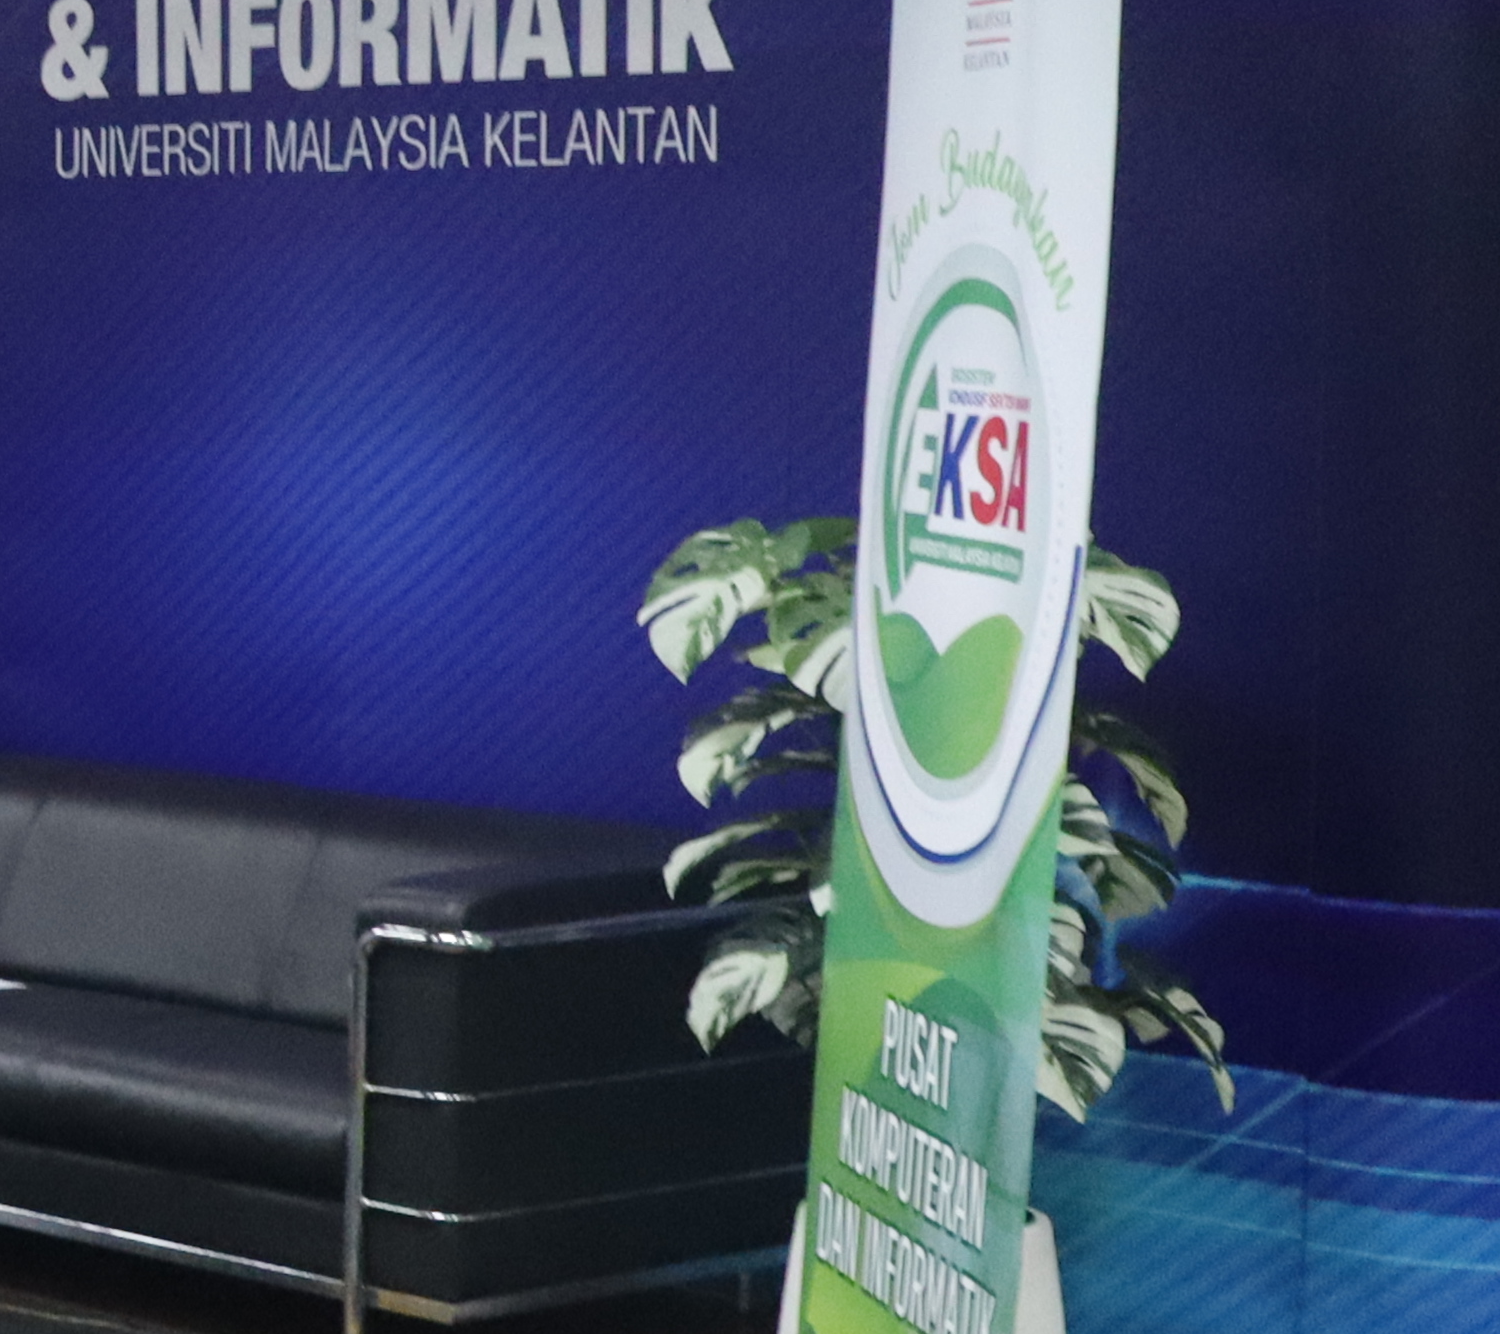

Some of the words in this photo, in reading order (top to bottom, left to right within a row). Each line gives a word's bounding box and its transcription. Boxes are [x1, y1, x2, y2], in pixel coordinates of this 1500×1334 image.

[54, 120, 253, 180] UNIVERSITI
[266, 113, 470, 173] MALAYSIA
[483, 105, 718, 168] KELANTAN
[902, 409, 1030, 533] EKSA
[881, 996, 958, 1112] PUSAT
[839, 1086, 989, 1252] KOMPUTERAN
[817, 1181, 859, 1280] DAN
